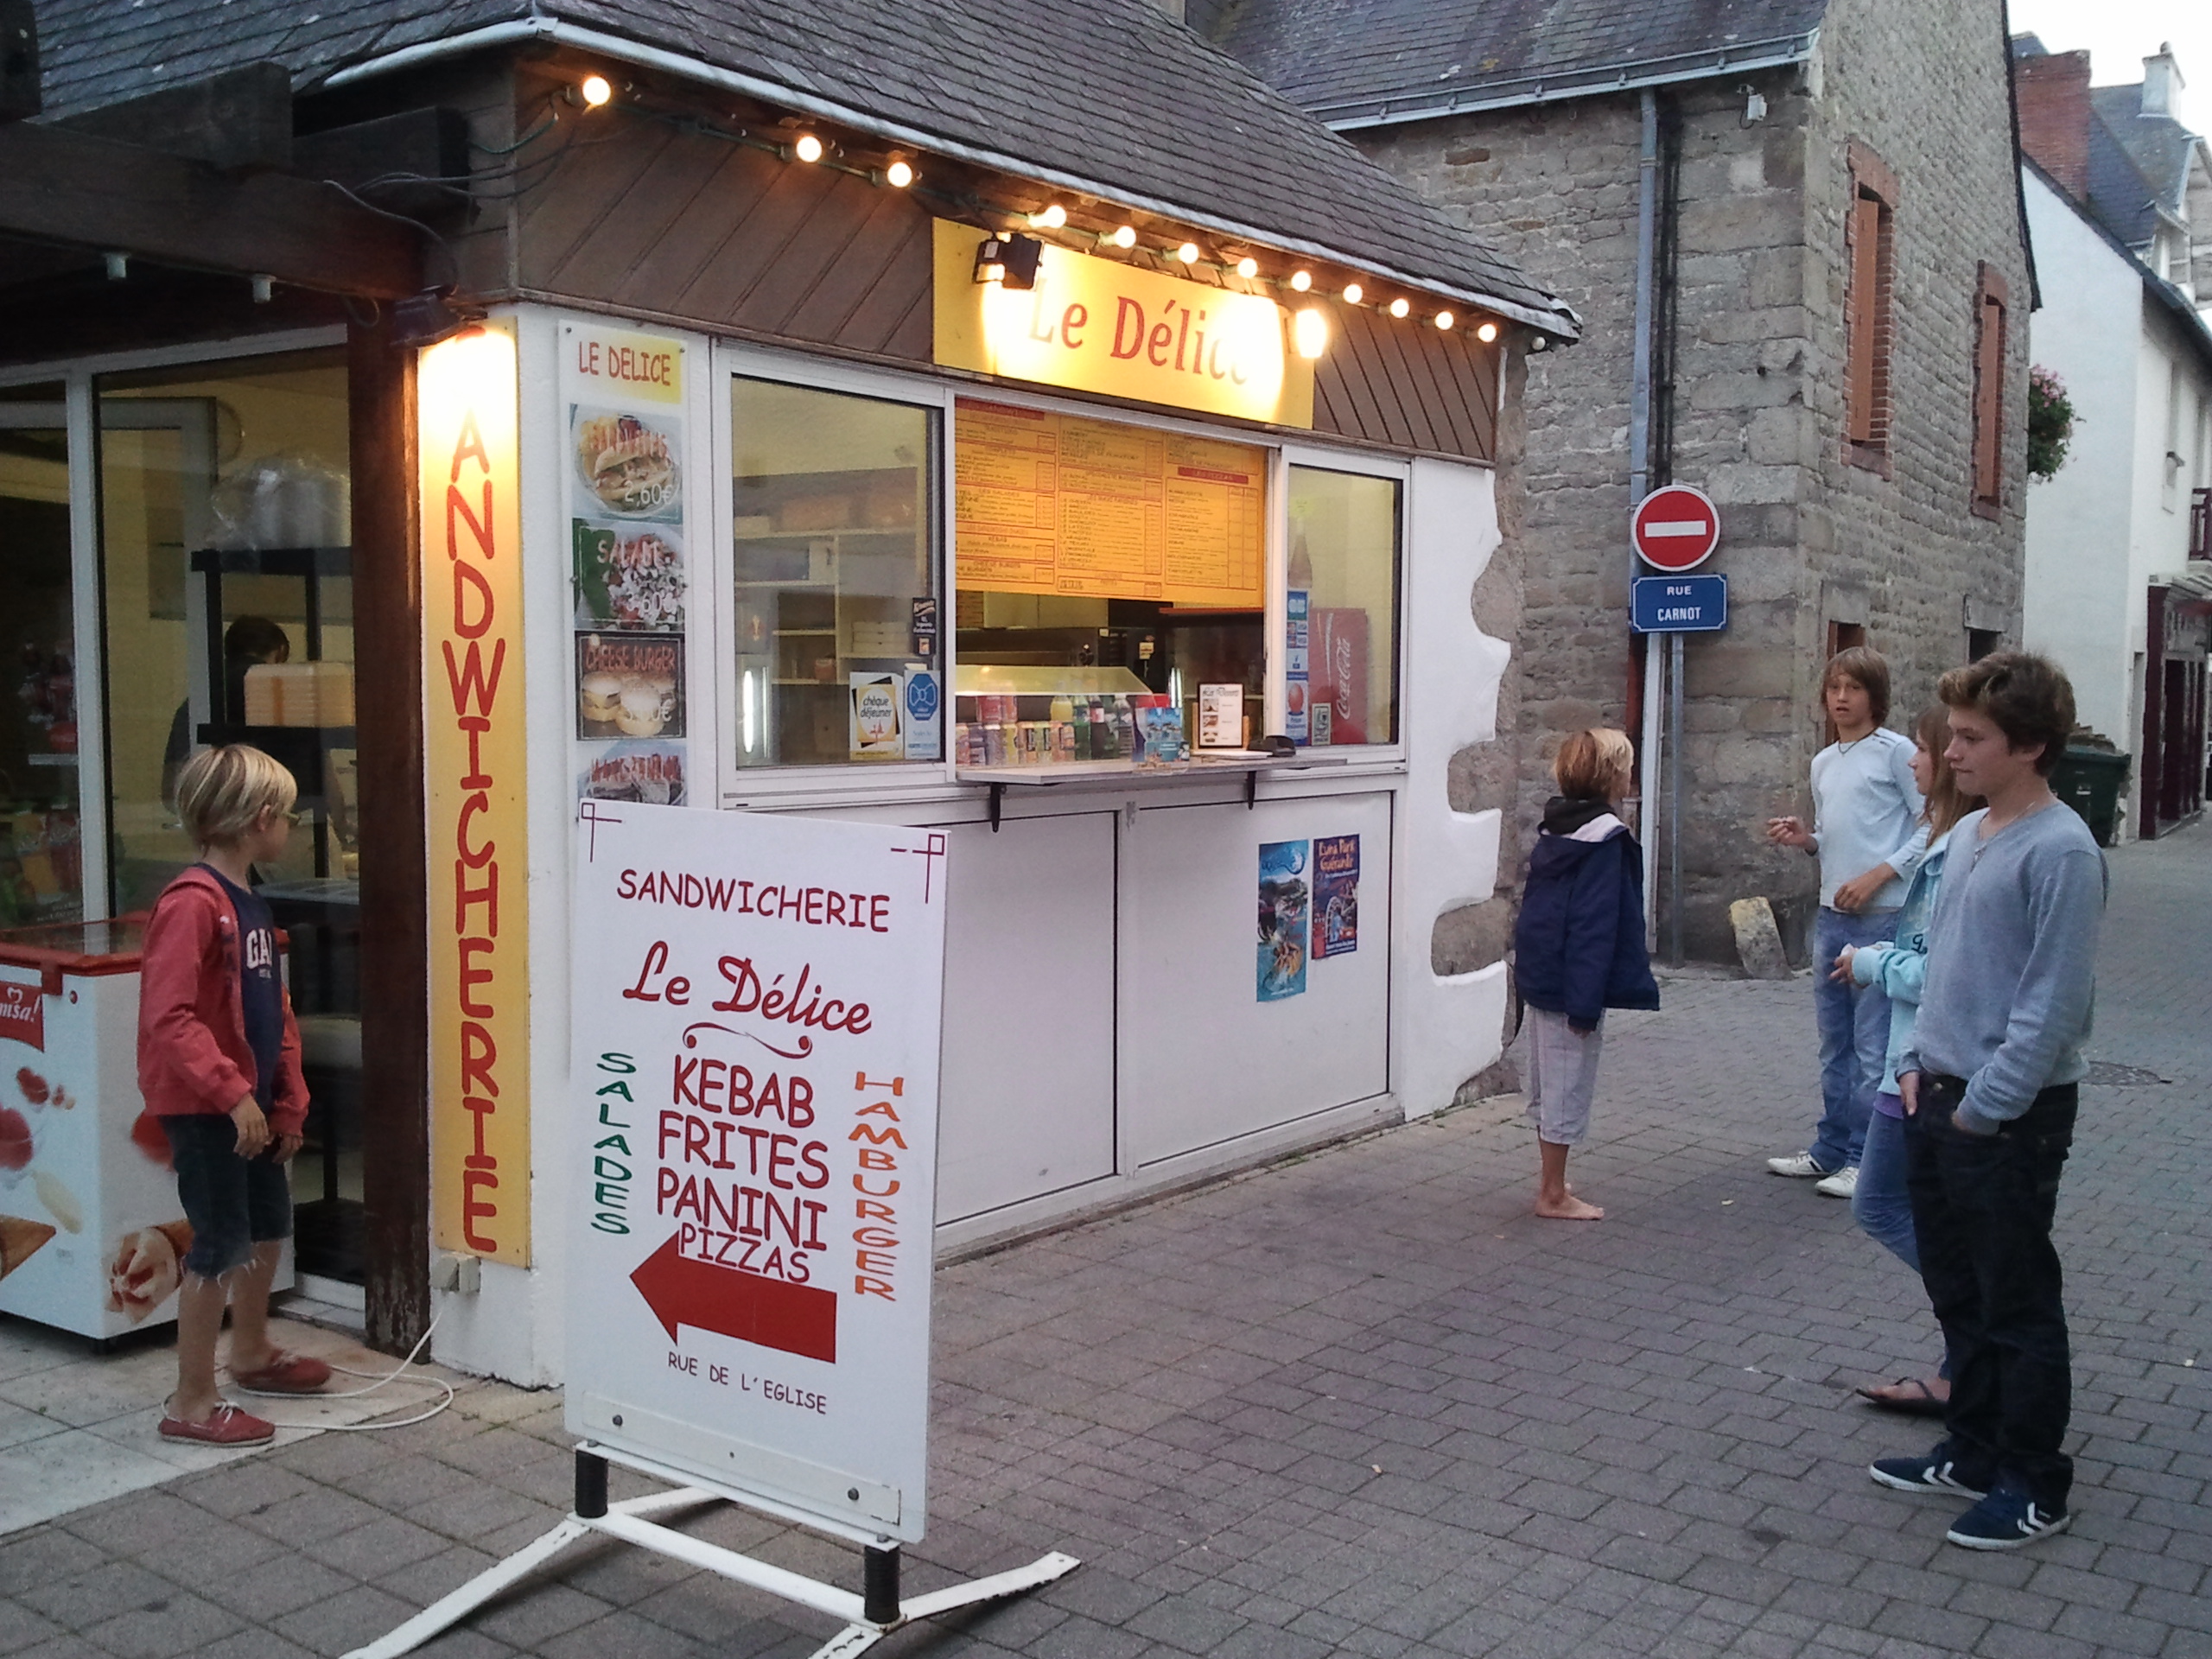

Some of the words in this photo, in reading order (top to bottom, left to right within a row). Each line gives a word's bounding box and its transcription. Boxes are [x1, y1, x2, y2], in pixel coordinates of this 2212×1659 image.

[1028, 277, 1088, 349] Le
[578, 340, 600, 376] LE
[608, 346, 671, 386] DELICE
[625, 480, 673, 507] 2,60€
[1657, 607, 1701, 621] CARNOT
[1667, 586, 1693, 595] RUE
[633, 645, 676, 671] BURGER
[860, 706, 892, 720] déjeuner
[862, 696, 889, 710] chèque
[442, 326, 506, 1252] ANDWICHERIE
[617, 868, 890, 932] SANDWICHERIE
[622, 940, 690, 1006] Le
[712, 956, 873, 1034] Délice
[673, 1054, 816, 1128] KEBAB
[590, 1052, 637, 1235] SALADES
[658, 1109, 830, 1190] FRITES
[658, 1167, 828, 1251] PANINI
[849, 1071, 908, 1301] HAMBURGER
[680, 1223, 810, 1283] PIZZAS
[668, 1351, 698, 1376] RUE
[709, 1364, 729, 1385] DE
